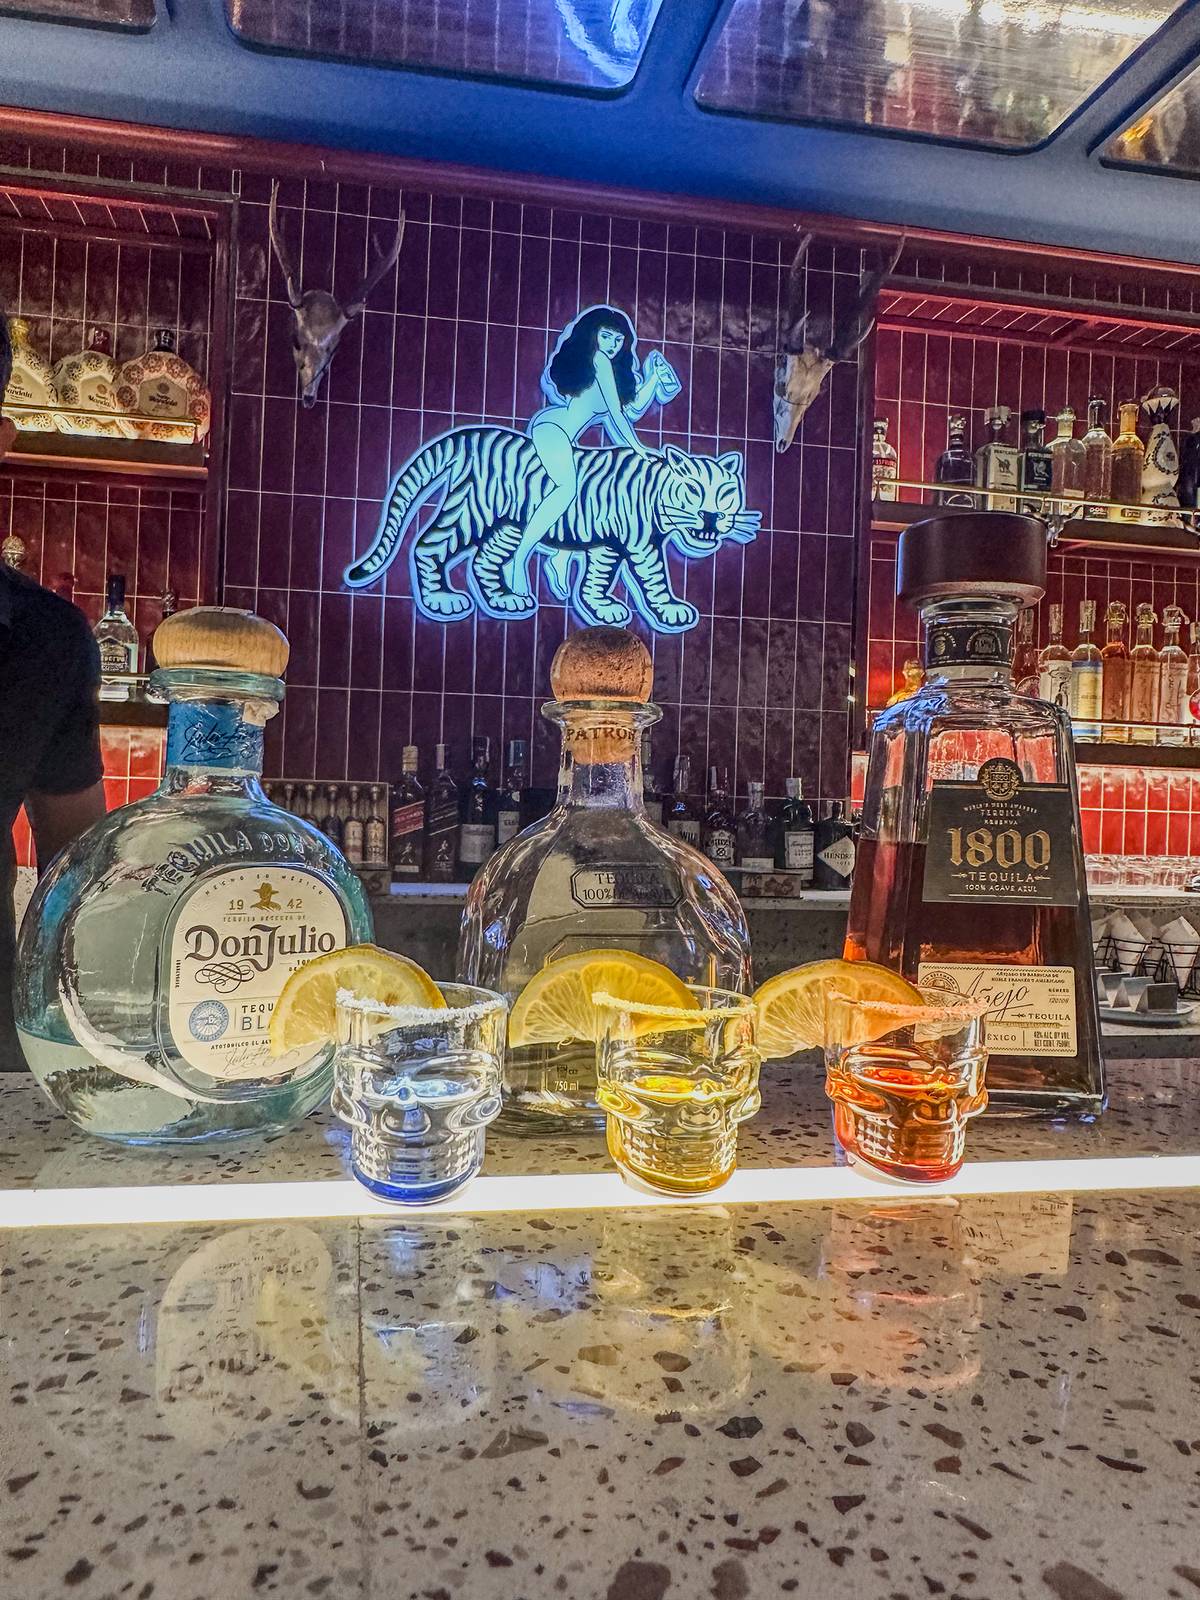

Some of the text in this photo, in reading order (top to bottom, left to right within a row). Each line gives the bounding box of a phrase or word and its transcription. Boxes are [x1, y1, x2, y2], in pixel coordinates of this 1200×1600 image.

[947, 827, 1051, 868] 1800
[968, 871, 1036, 883] TEQUILA
[582, 888, 612, 900] 100%
[965, 884, 987, 892] 100%
[988, 884, 1015, 892] AGAVE
[228, 899, 245, 911] 19
[286, 898, 304, 910] 42
[241, 1002, 274, 1014] TEQU
[1028, 1013, 1072, 1021] TEQUILA
[554, 1080, 568, 1092] 750
